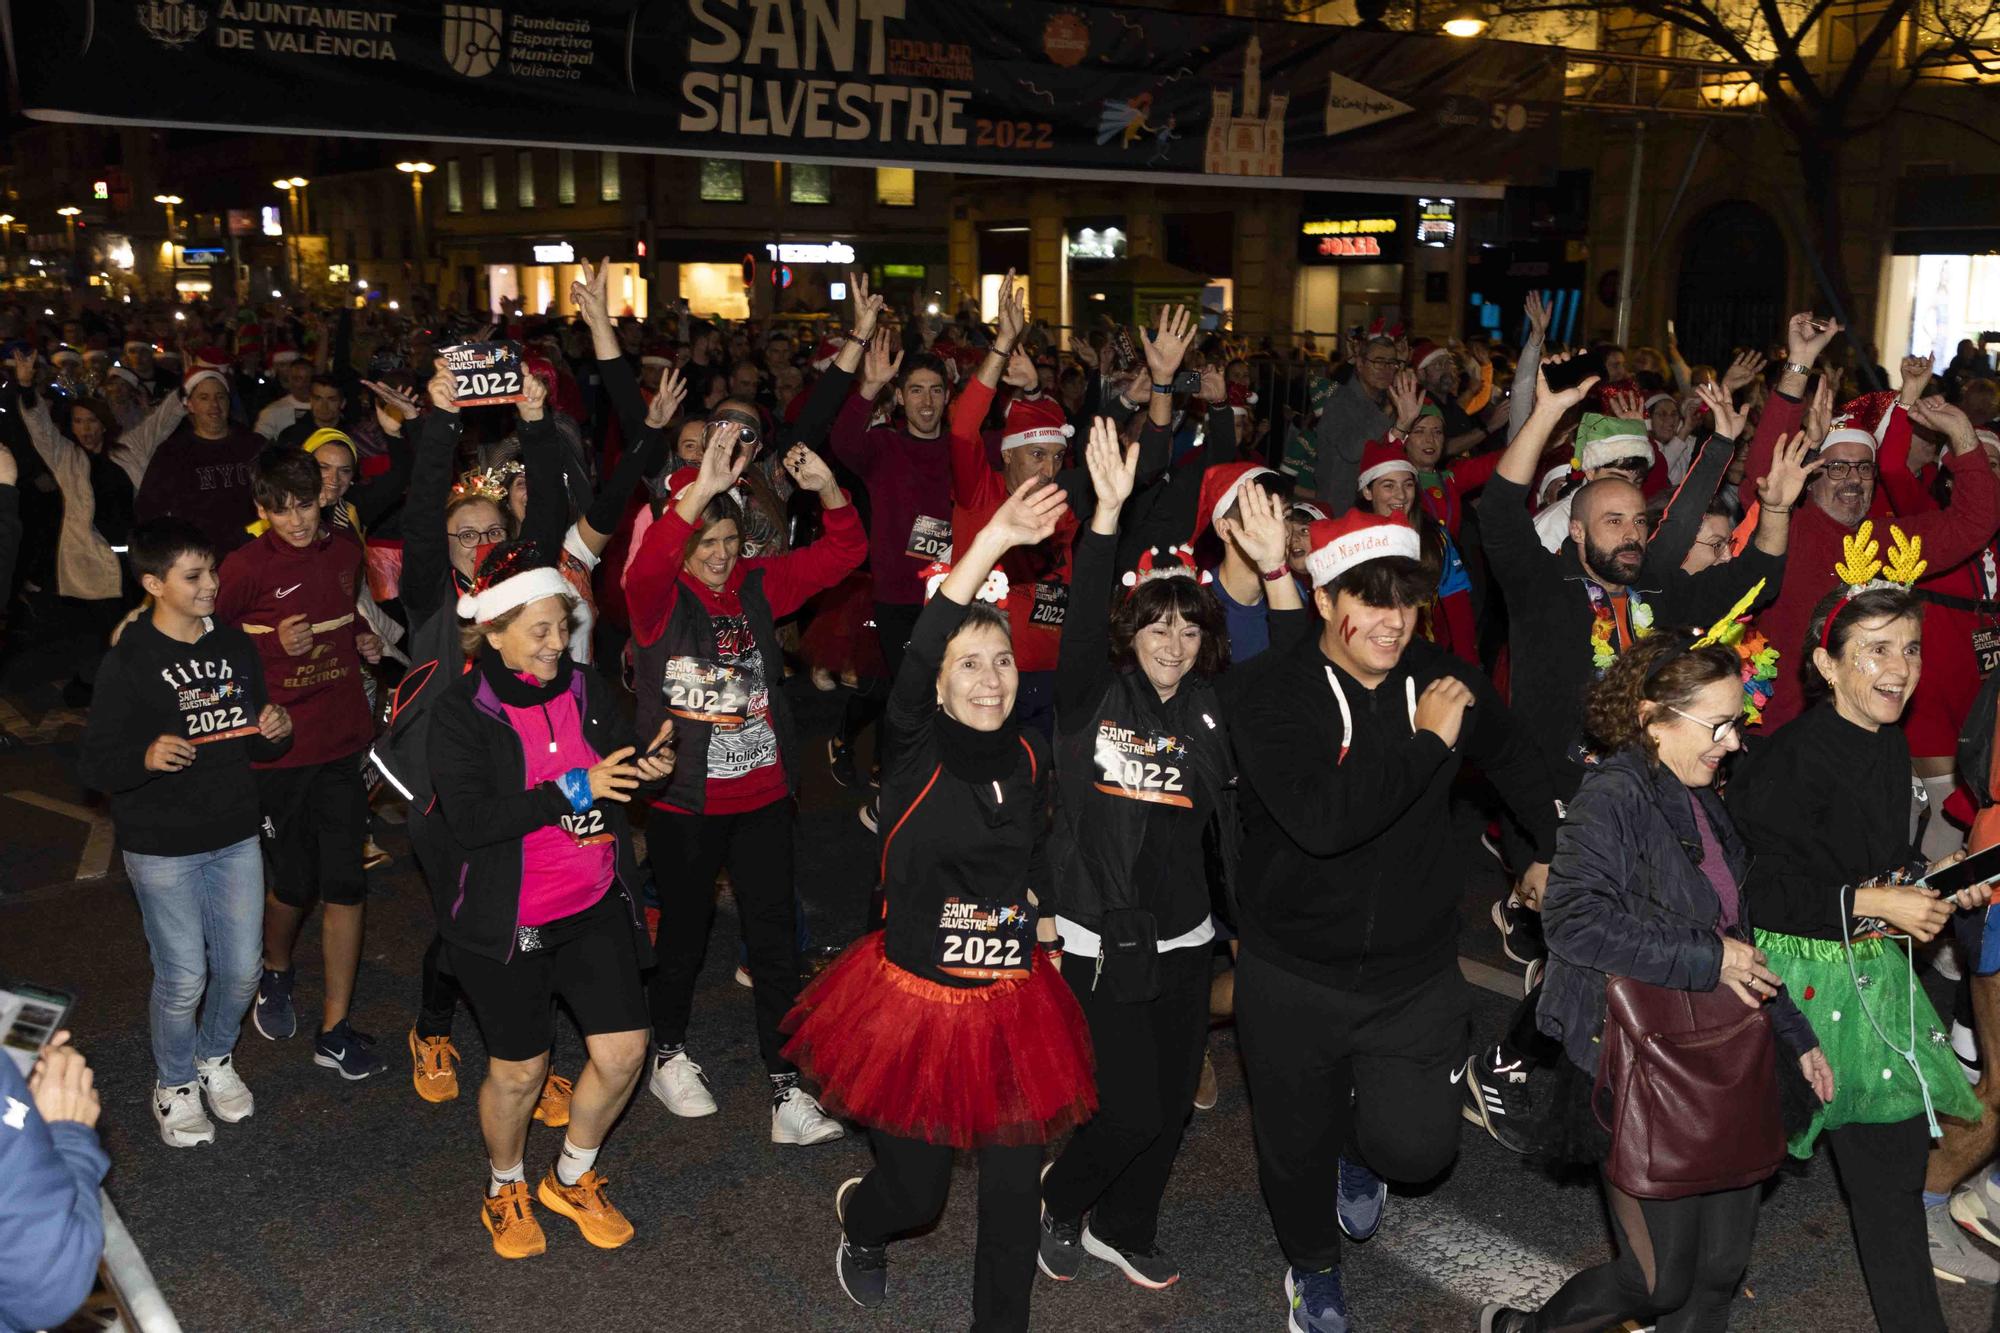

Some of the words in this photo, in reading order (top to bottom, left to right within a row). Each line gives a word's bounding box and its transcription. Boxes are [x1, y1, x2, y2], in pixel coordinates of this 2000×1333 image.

[218, 0, 397, 33] AJUNTAMENT
[512, 14, 591, 33] Fundació
[217, 27, 255, 50] DE
[264, 31, 397, 61] VALÈNCIA
[511, 31, 593, 49] Esportiva
[688, 0, 905, 76] SANT
[511, 47, 593, 66] Municipal
[511, 63, 582, 80] València
[975, 119, 1054, 150] 2022
[456, 371, 521, 397] 2022
[1033, 603, 1066, 624] 2022
[161, 658, 233, 690] fitch
[283, 667, 349, 688] ELECTRON
[665, 659, 698, 674] SANT
[178, 688, 201, 702] SANT
[670, 685, 738, 714] 2022
[186, 706, 248, 736] 2022
[1100, 726, 1135, 743] SANT
[560, 809, 605, 836] 022
[942, 903, 979, 919] SANT
[942, 934, 1022, 967] 2022
